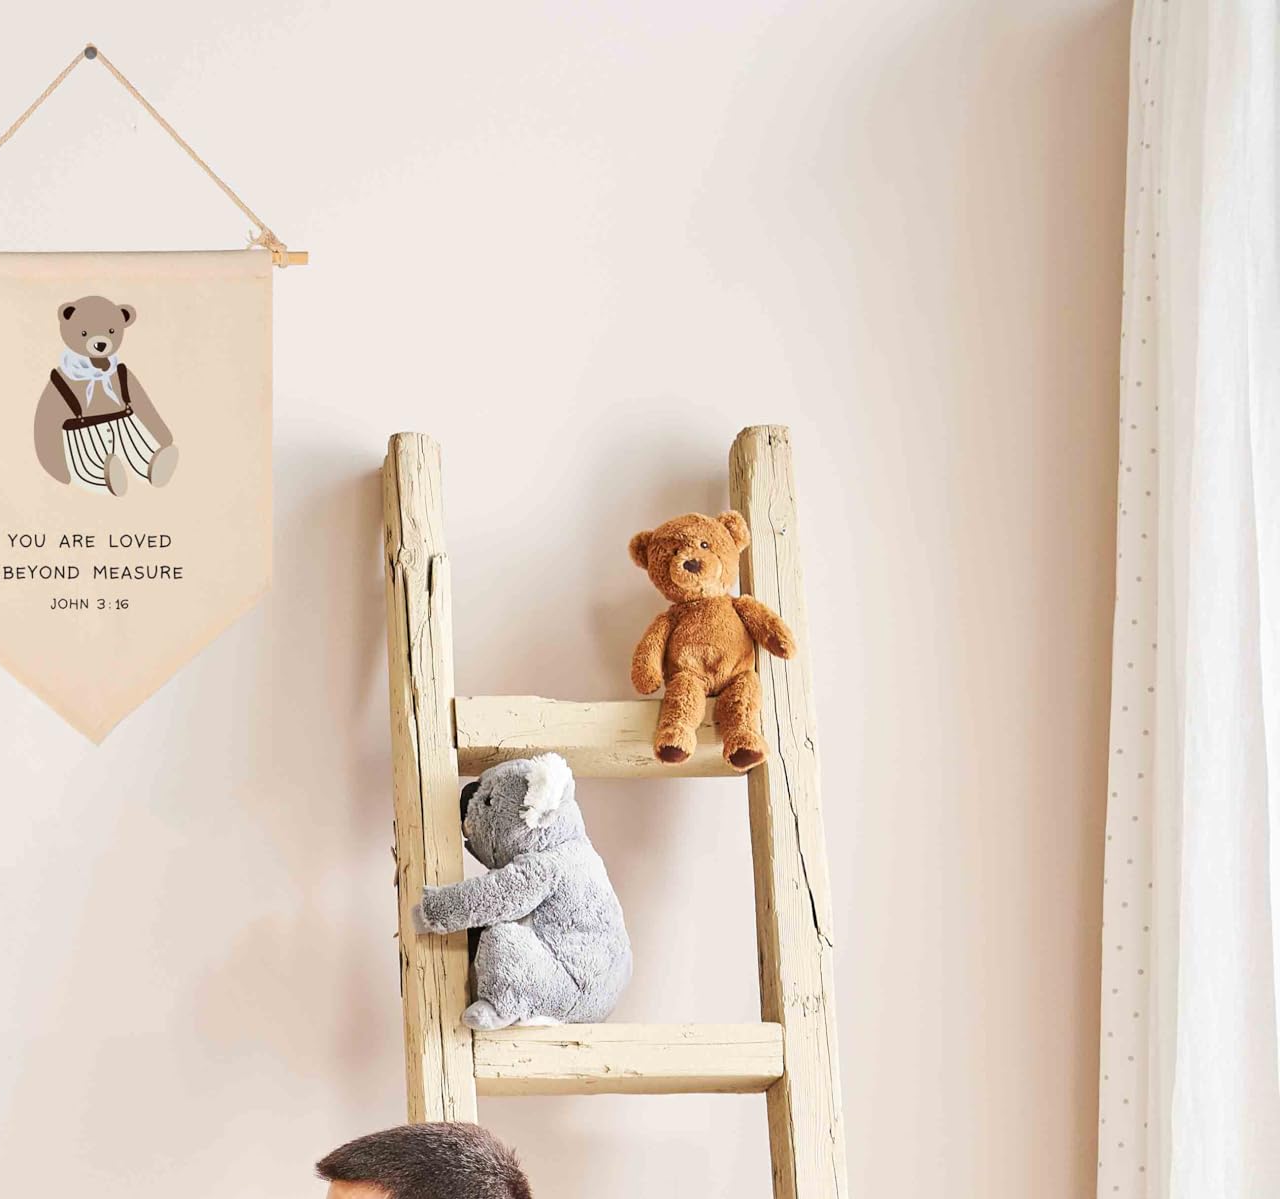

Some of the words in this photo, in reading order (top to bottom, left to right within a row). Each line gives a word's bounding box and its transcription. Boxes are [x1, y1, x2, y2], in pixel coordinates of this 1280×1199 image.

[7, 533, 46, 548] YOU
[59, 534, 96, 549] ARE
[109, 533, 172, 549] LOVED
[2, 564, 80, 580] BEYOND
[93, 564, 183, 580] MEASURE
[50, 598, 89, 610] JOHN
